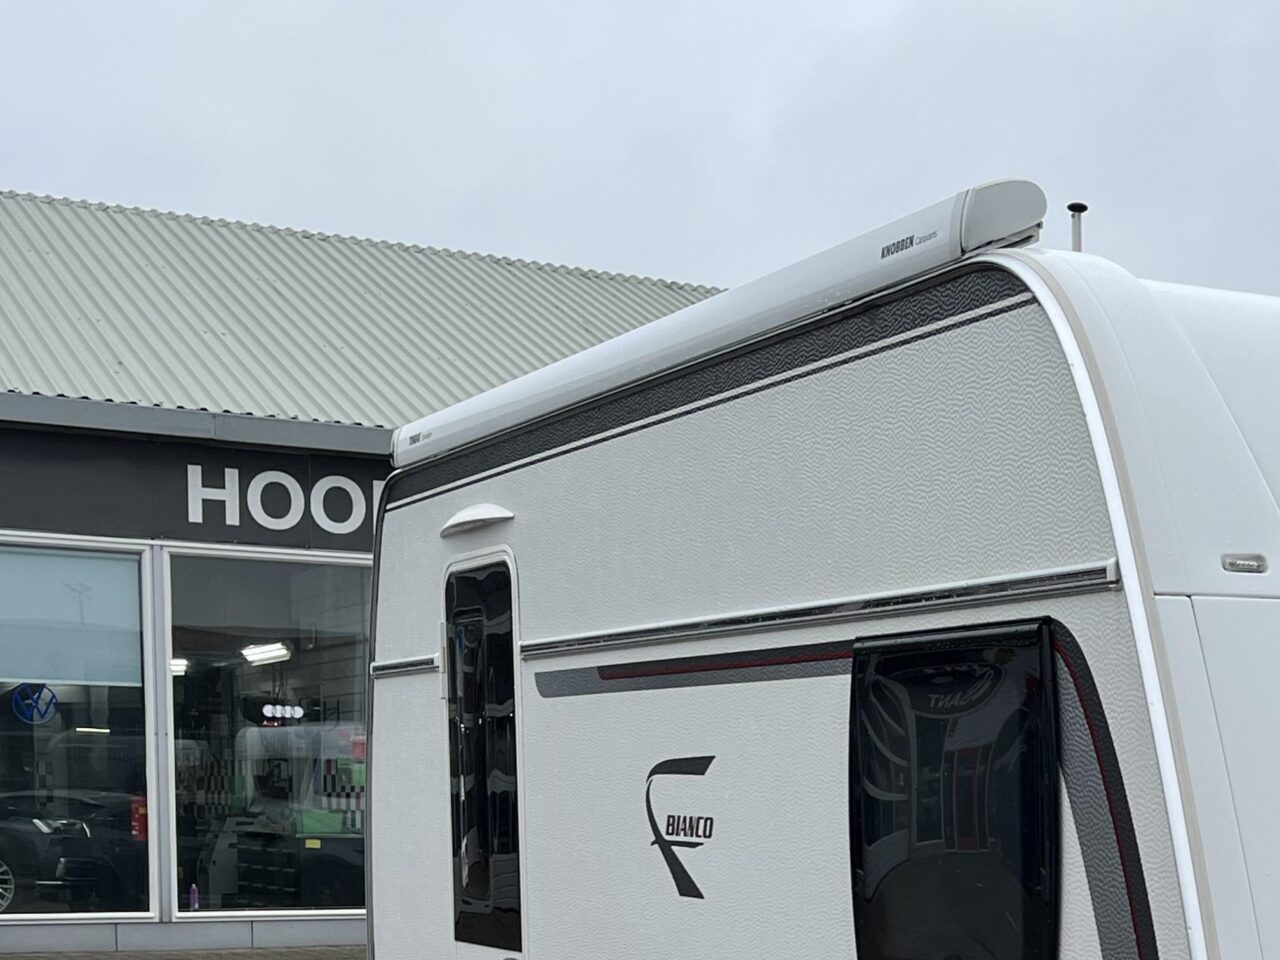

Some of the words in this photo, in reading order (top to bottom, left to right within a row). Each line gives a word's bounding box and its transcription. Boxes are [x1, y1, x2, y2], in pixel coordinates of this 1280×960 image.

[881, 234, 915, 259] KNOBBEN
[187, 464, 386, 535] HOO
[665, 814, 714, 839] BIANCO
